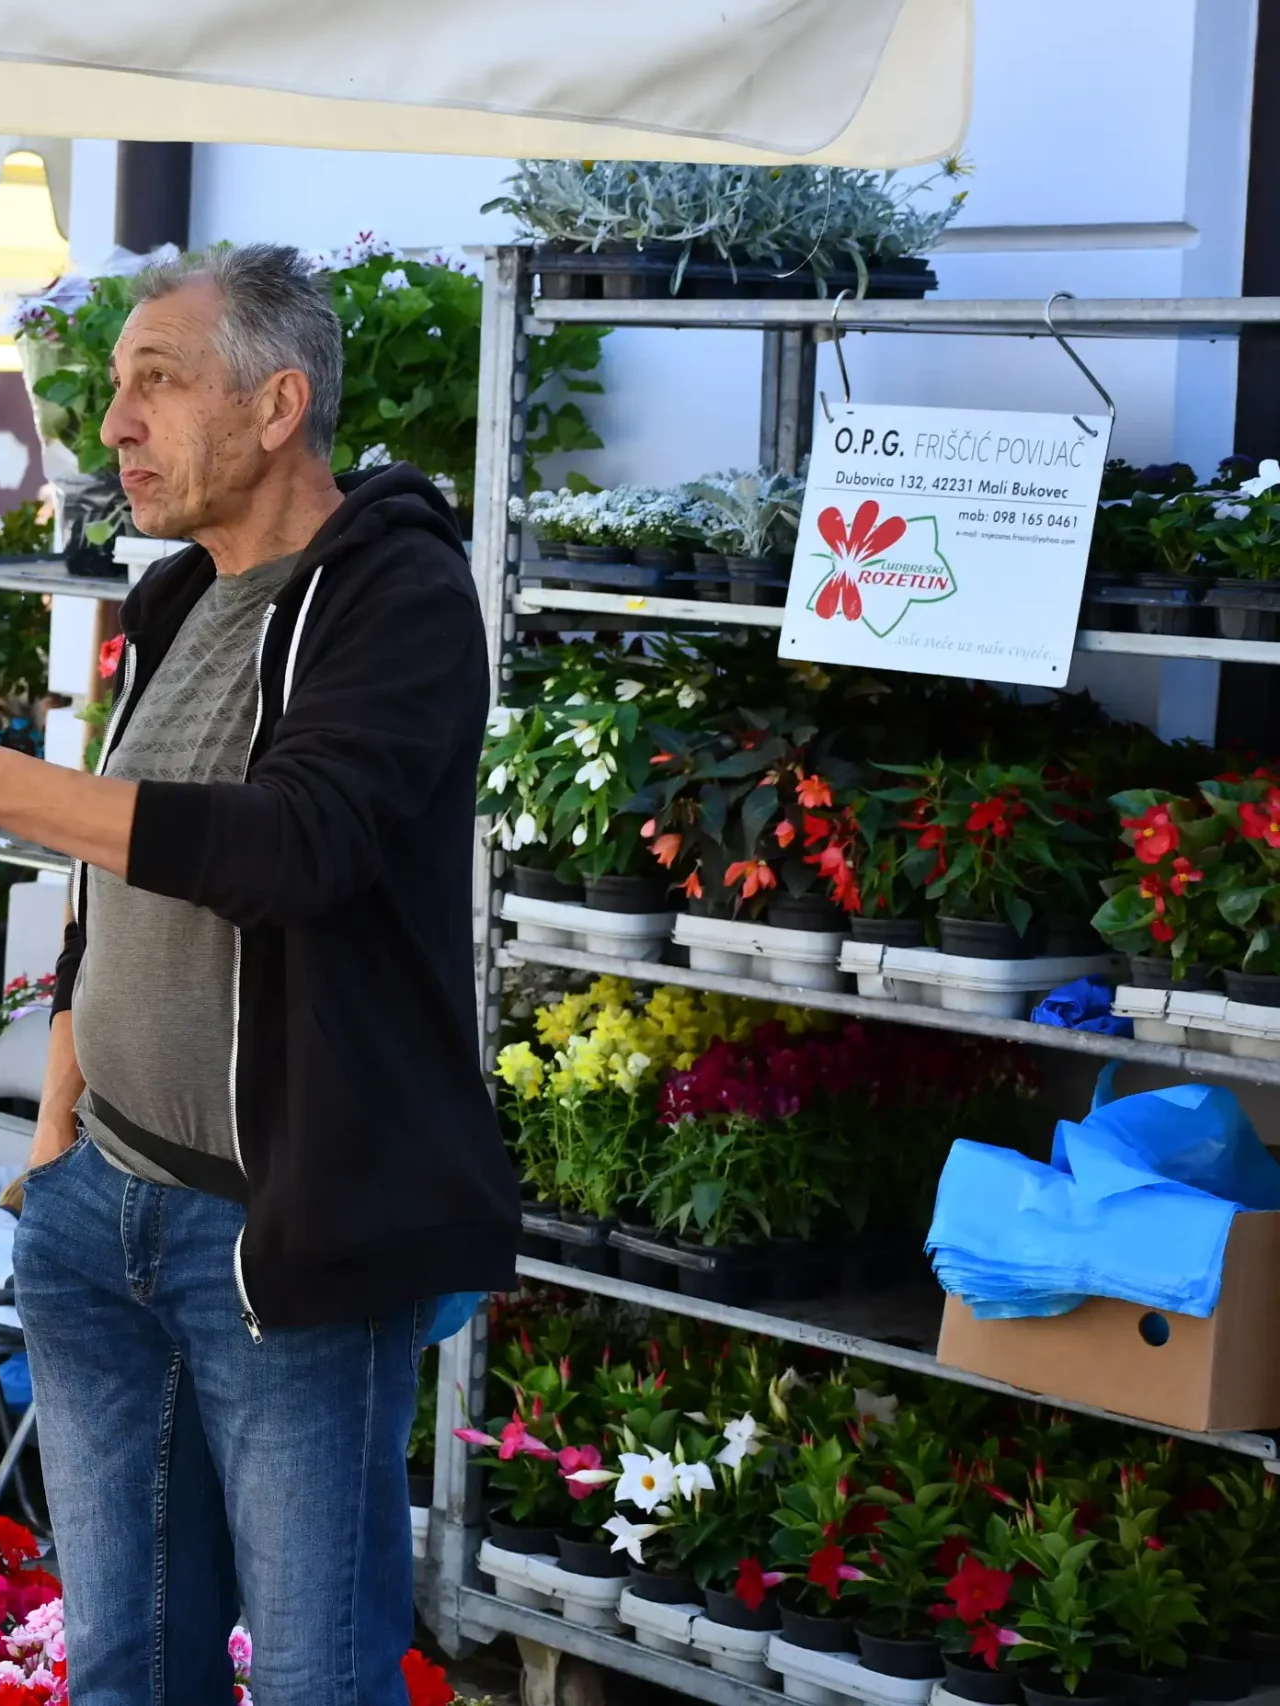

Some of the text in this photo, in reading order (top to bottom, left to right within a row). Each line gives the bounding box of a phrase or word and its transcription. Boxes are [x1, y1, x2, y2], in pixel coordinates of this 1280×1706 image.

[835, 427, 1085, 468] O.P.G. FRIŠČIĆ POVIJAČ
[836, 470, 1069, 499] Dubovica 132, 42231 Mali Bukovec
[958, 509, 1078, 528] mob: 098 165 0461
[858, 570, 949, 590] ROZETLIN
